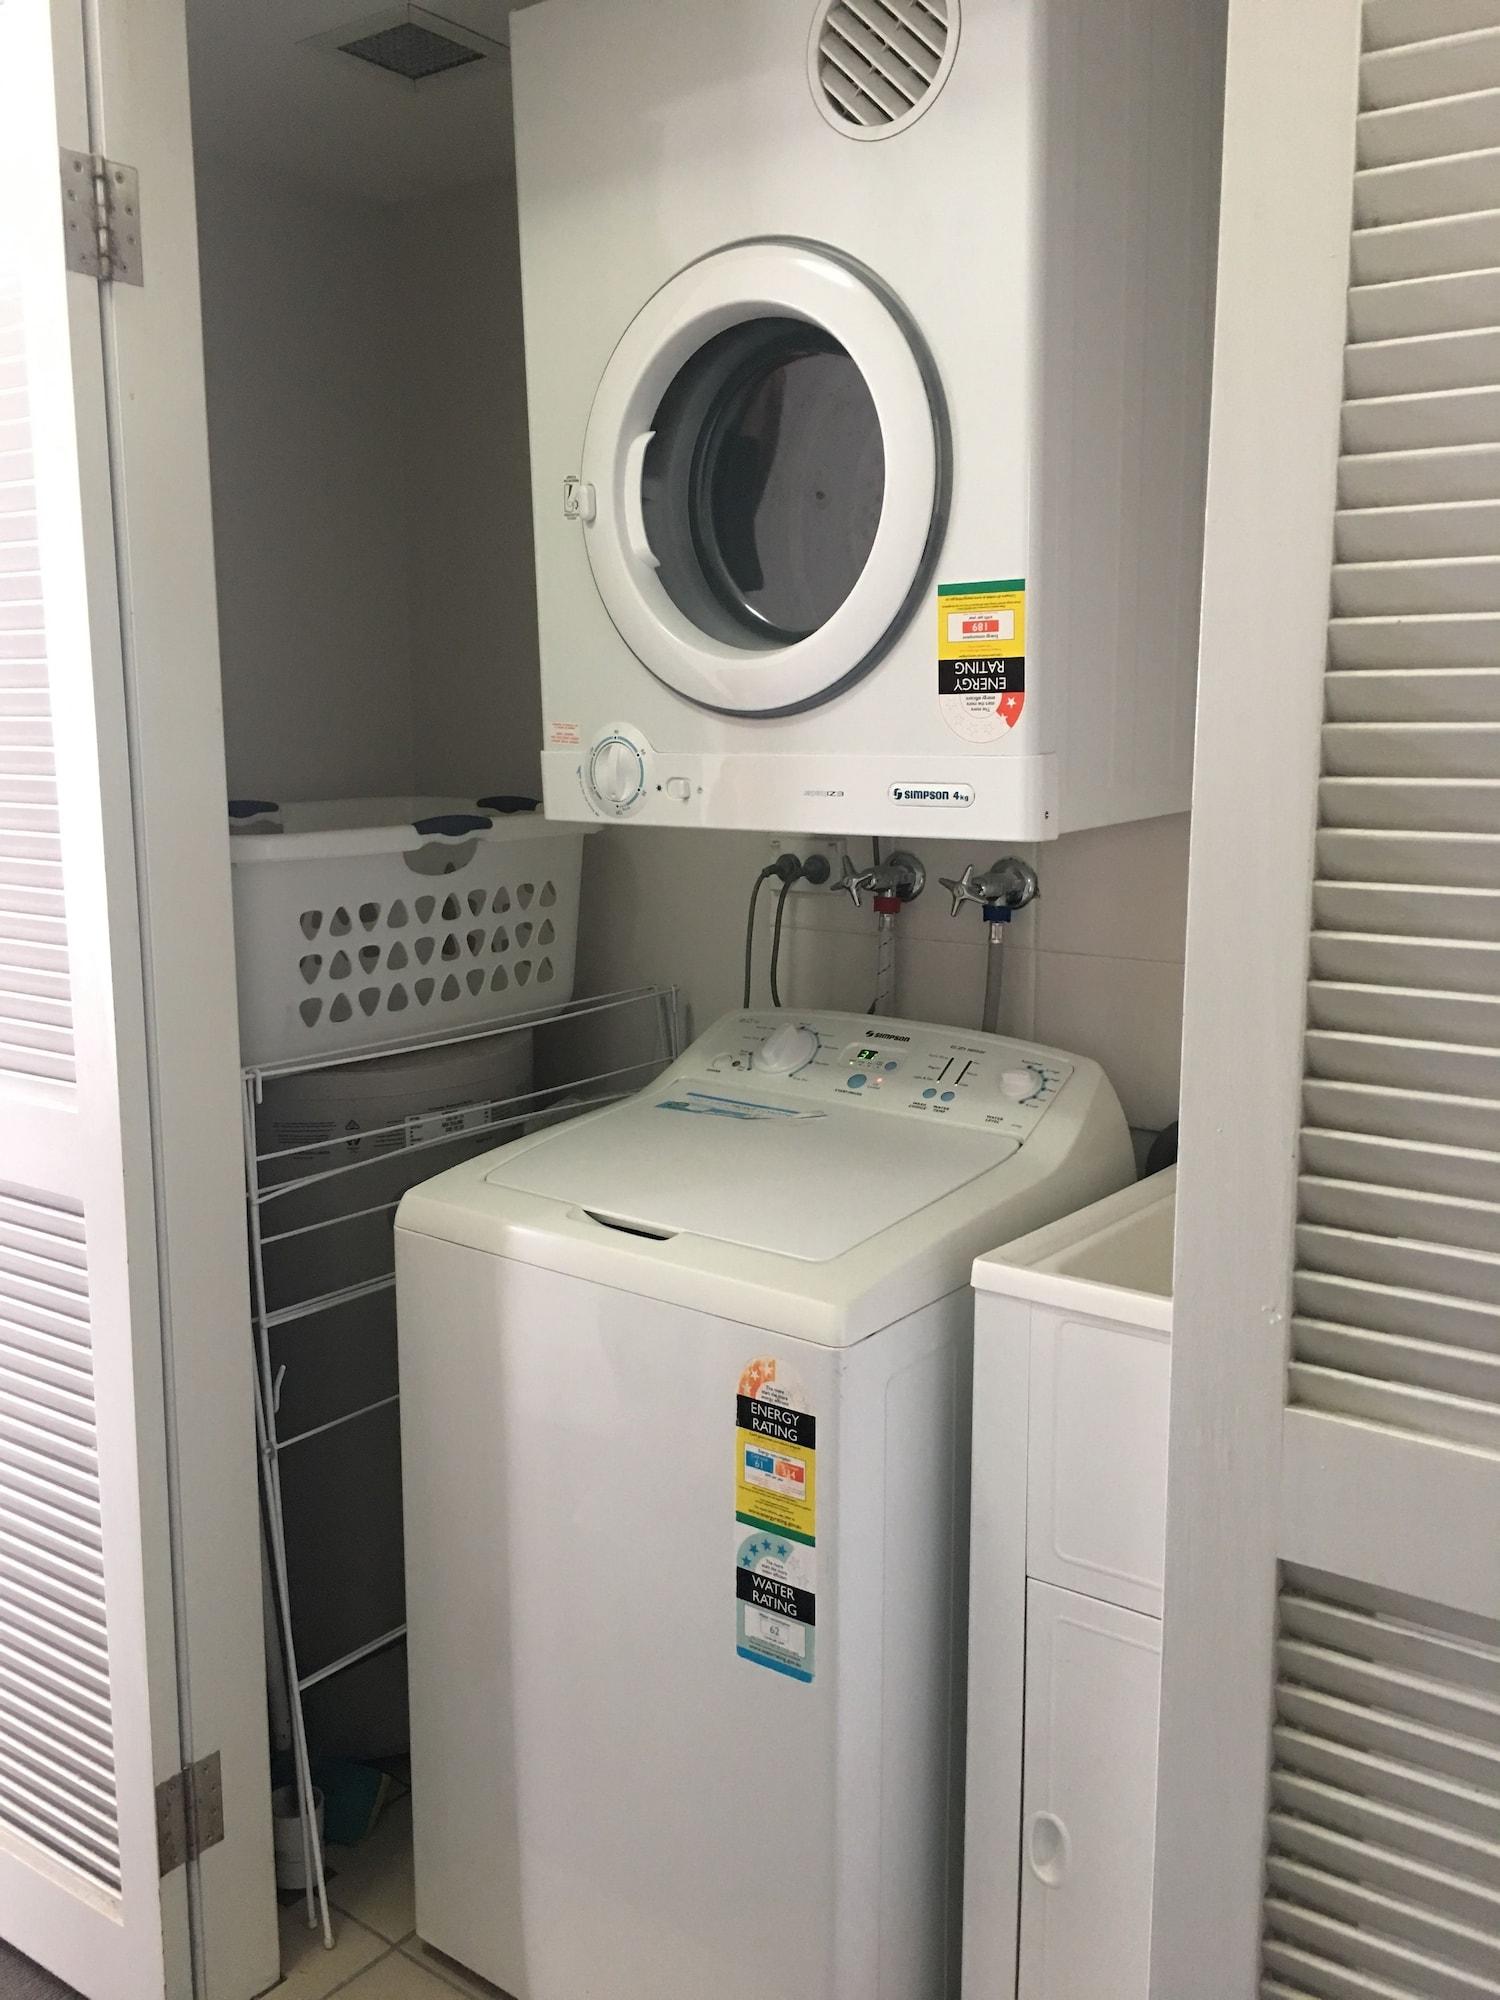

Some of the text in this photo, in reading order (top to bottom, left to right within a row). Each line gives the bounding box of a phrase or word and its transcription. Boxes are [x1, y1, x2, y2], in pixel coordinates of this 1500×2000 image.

[972, 622, 988, 632] 189
[954, 660, 1005, 675] RATING
[953, 677, 1007, 691] ENERGY
[751, 1402, 799, 1426] ENERGY
[753, 1418, 797, 1442] RATING
[752, 1574, 795, 1601] WATER
[753, 1590, 797, 1616] RATING
[769, 1625, 780, 1636] 62
